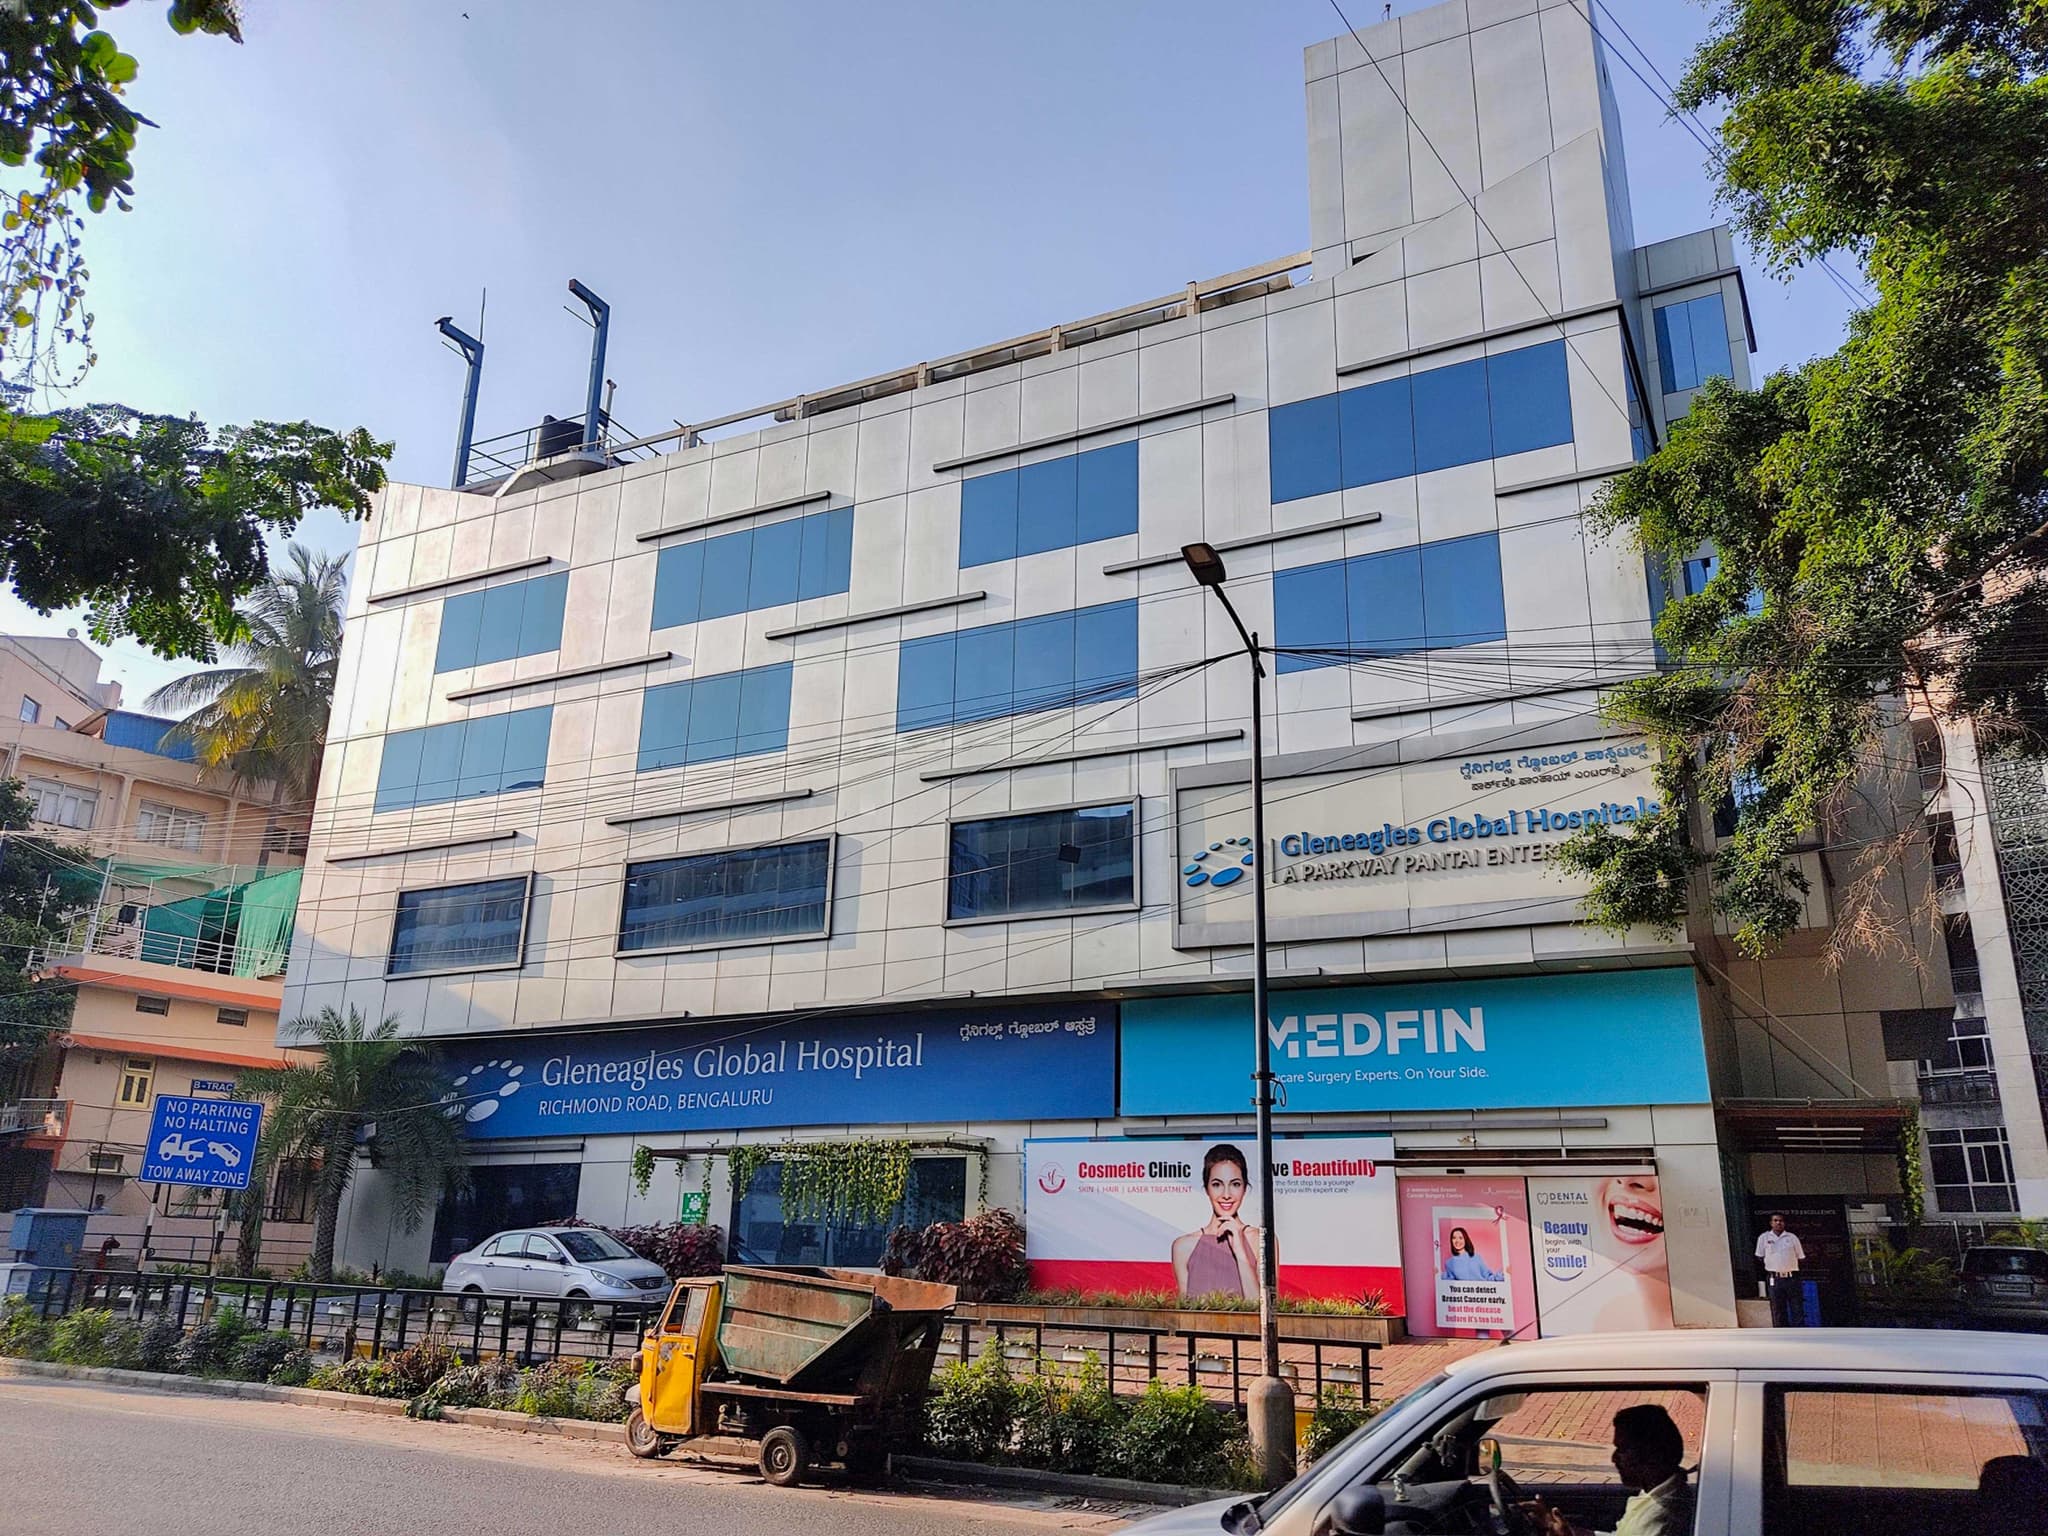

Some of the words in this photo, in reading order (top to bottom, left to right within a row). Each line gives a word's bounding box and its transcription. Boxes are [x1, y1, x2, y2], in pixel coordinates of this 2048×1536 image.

[1280, 823, 1421, 857] Gleneagles
[1427, 810, 1518, 844] Global
[1525, 796, 1662, 834] Hospitals
[1283, 866, 1298, 884] A
[1301, 856, 1399, 883] PARKWAY
[1404, 848, 1479, 874] PANTAI
[541, 1050, 684, 1092] Gleneagles
[692, 1041, 786, 1080] Global
[797, 1032, 924, 1079] Hospital
[1307, 1071, 1352, 1085] Surgery
[1355, 1069, 1402, 1084] Experts.
[1405, 1067, 1424, 1080] On
[1427, 1066, 1456, 1080] Your
[1459, 1065, 1489, 1079] Side.
[193, 1081, 234, 1092] B-TRAC
[166, 1101, 188, 1114] NO
[191, 1103, 253, 1119] PARKING
[538, 1095, 622, 1117] RICHMOND
[626, 1092, 673, 1114] ROAD,
[677, 1088, 773, 1110] BENGALURU
[164, 1116, 186, 1129] NO
[189, 1118, 249, 1134] HALTING
[147, 1165, 174, 1179] TOW
[175, 1168, 210, 1182] AWAY
[211, 1171, 245, 1185] ZONE
[1078, 1161, 1146, 1179] Cosmetic
[1148, 1161, 1192, 1179] Clinic
[1292, 1159, 1377, 1178] Beautifully
[1550, 1192, 1588, 1201] DENTAL
[1544, 1221, 1588, 1236] Beauty
[1545, 1238, 1566, 1246] begins
[1547, 1255, 1588, 1268] smile!
[1449, 1285, 1461, 1293] You
[1475, 1286, 1496, 1294] detect
[1442, 1295, 1463, 1303] Breast
